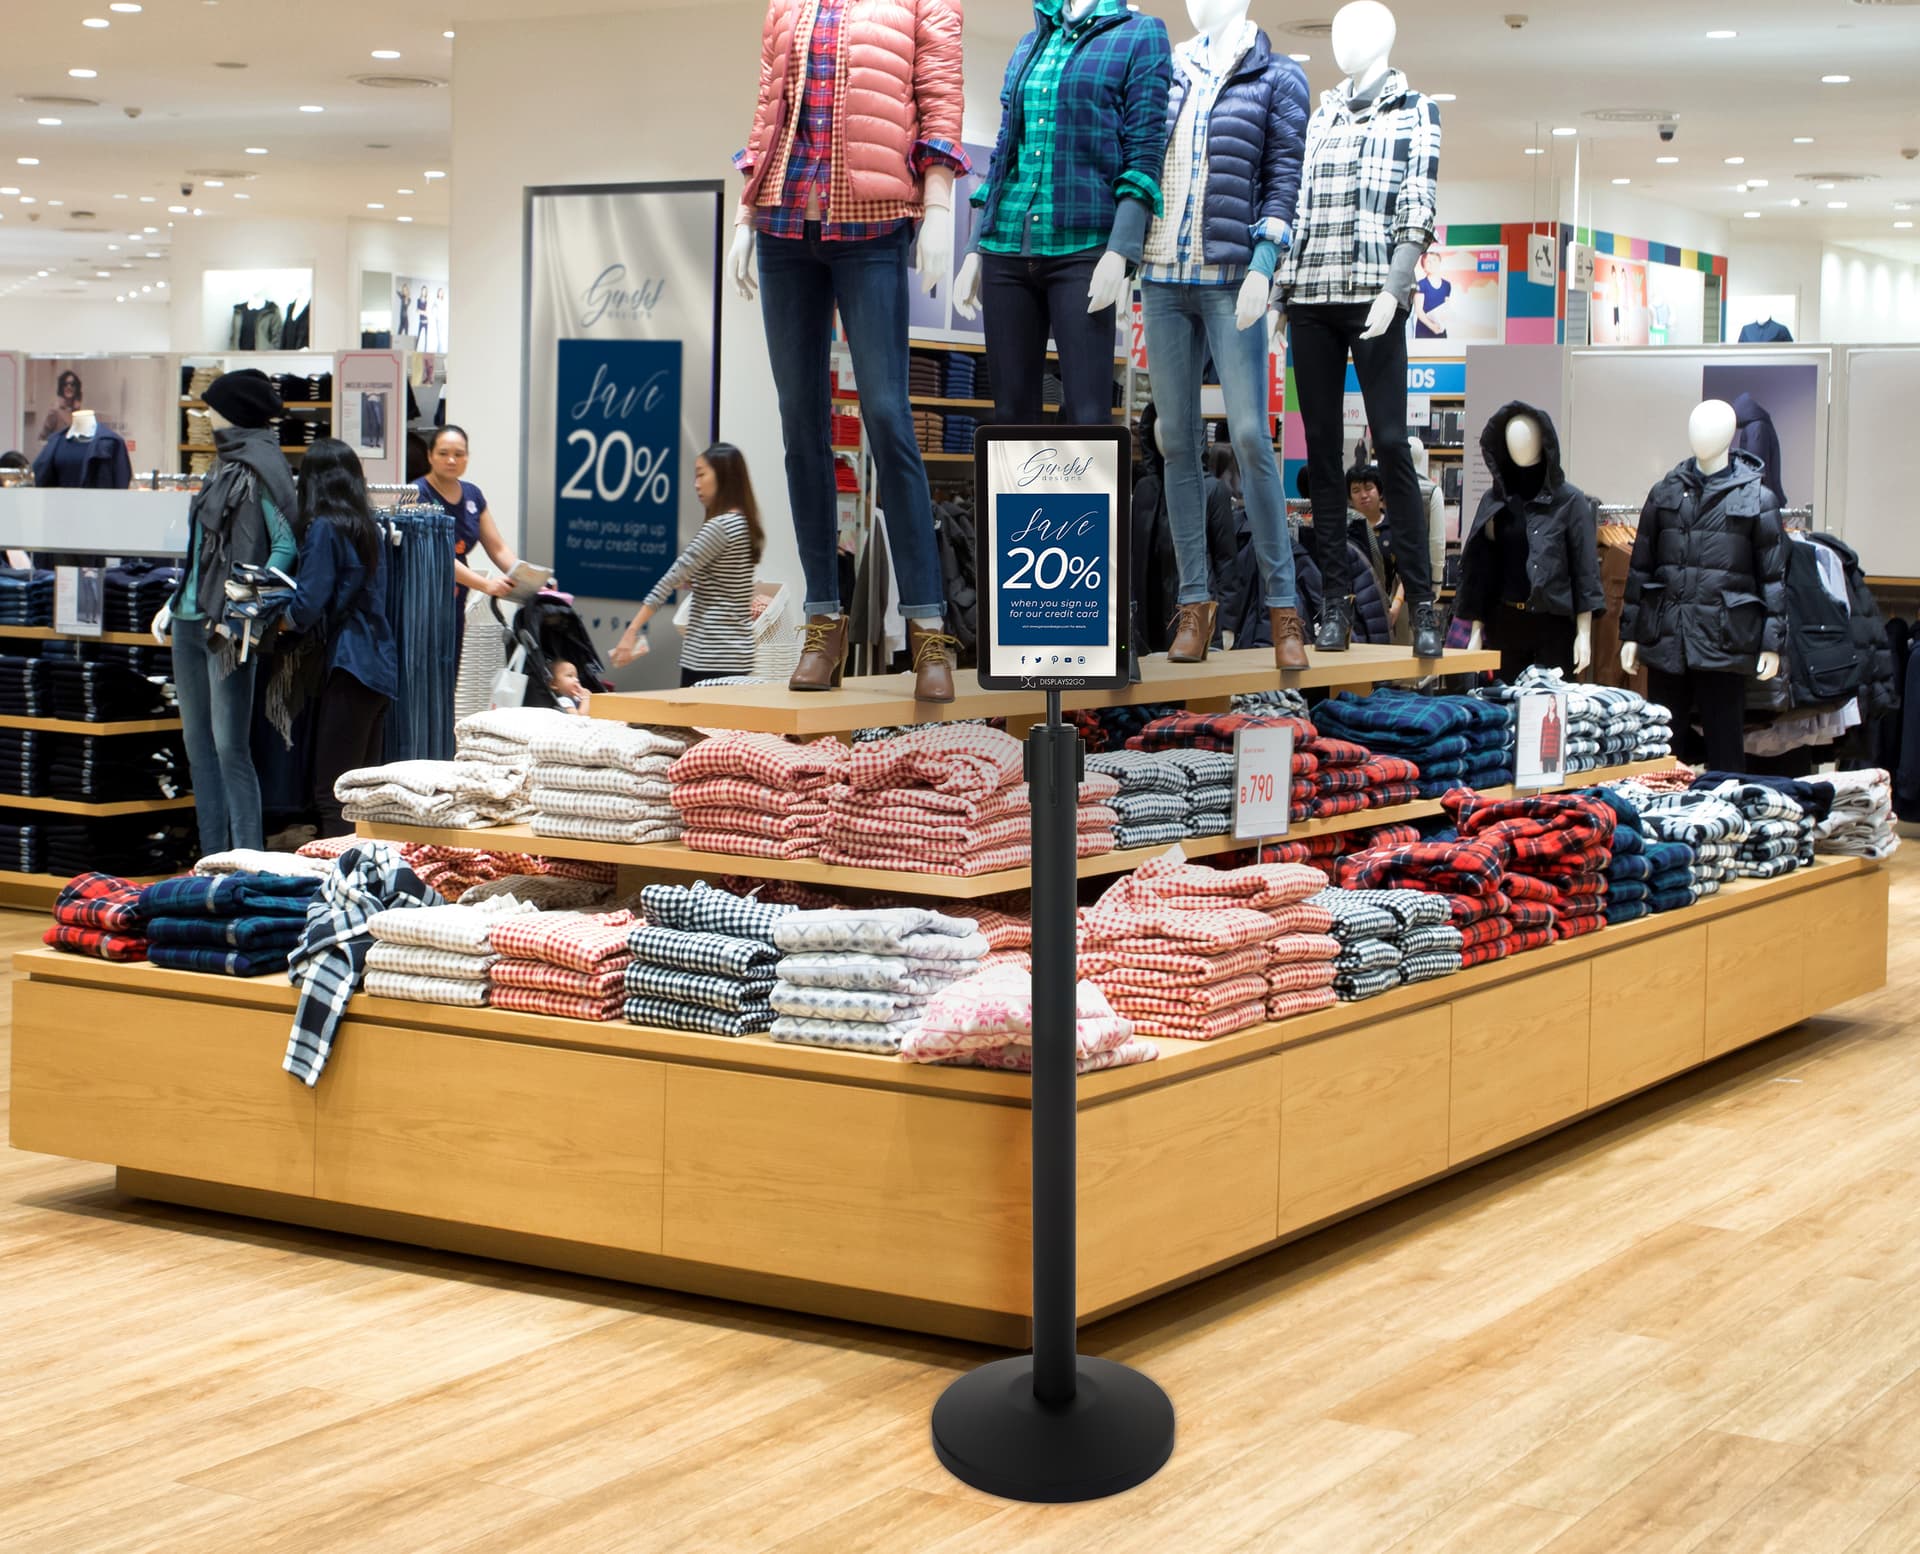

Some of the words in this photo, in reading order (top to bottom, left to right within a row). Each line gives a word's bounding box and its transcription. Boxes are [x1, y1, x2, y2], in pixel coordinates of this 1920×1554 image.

[1407, 368, 1435, 388] IDS
[571, 363, 669, 420] Save
[560, 429, 670, 504] 20%
[568, 518, 598, 531] when
[601, 521, 621, 535] you
[624, 520, 648, 537] sign
[650, 524, 666, 537] up
[1010, 508, 1099, 542] Save
[567, 534, 581, 548] for
[584, 539, 602, 550] our
[605, 539, 638, 552] credit
[641, 541, 667, 555] card
[1002, 547, 1101, 590] 20%
[1009, 610, 1023, 618] for
[1044, 610, 1074, 618] credit
[1076, 610, 1100, 618] card
[1010, 599, 1038, 608] when
[1040, 601, 1058, 609] you
[1061, 599, 1082, 609] sign
[1084, 601, 1098, 609] up
[1040, 678, 1086, 686] DISPLAYS2GO
